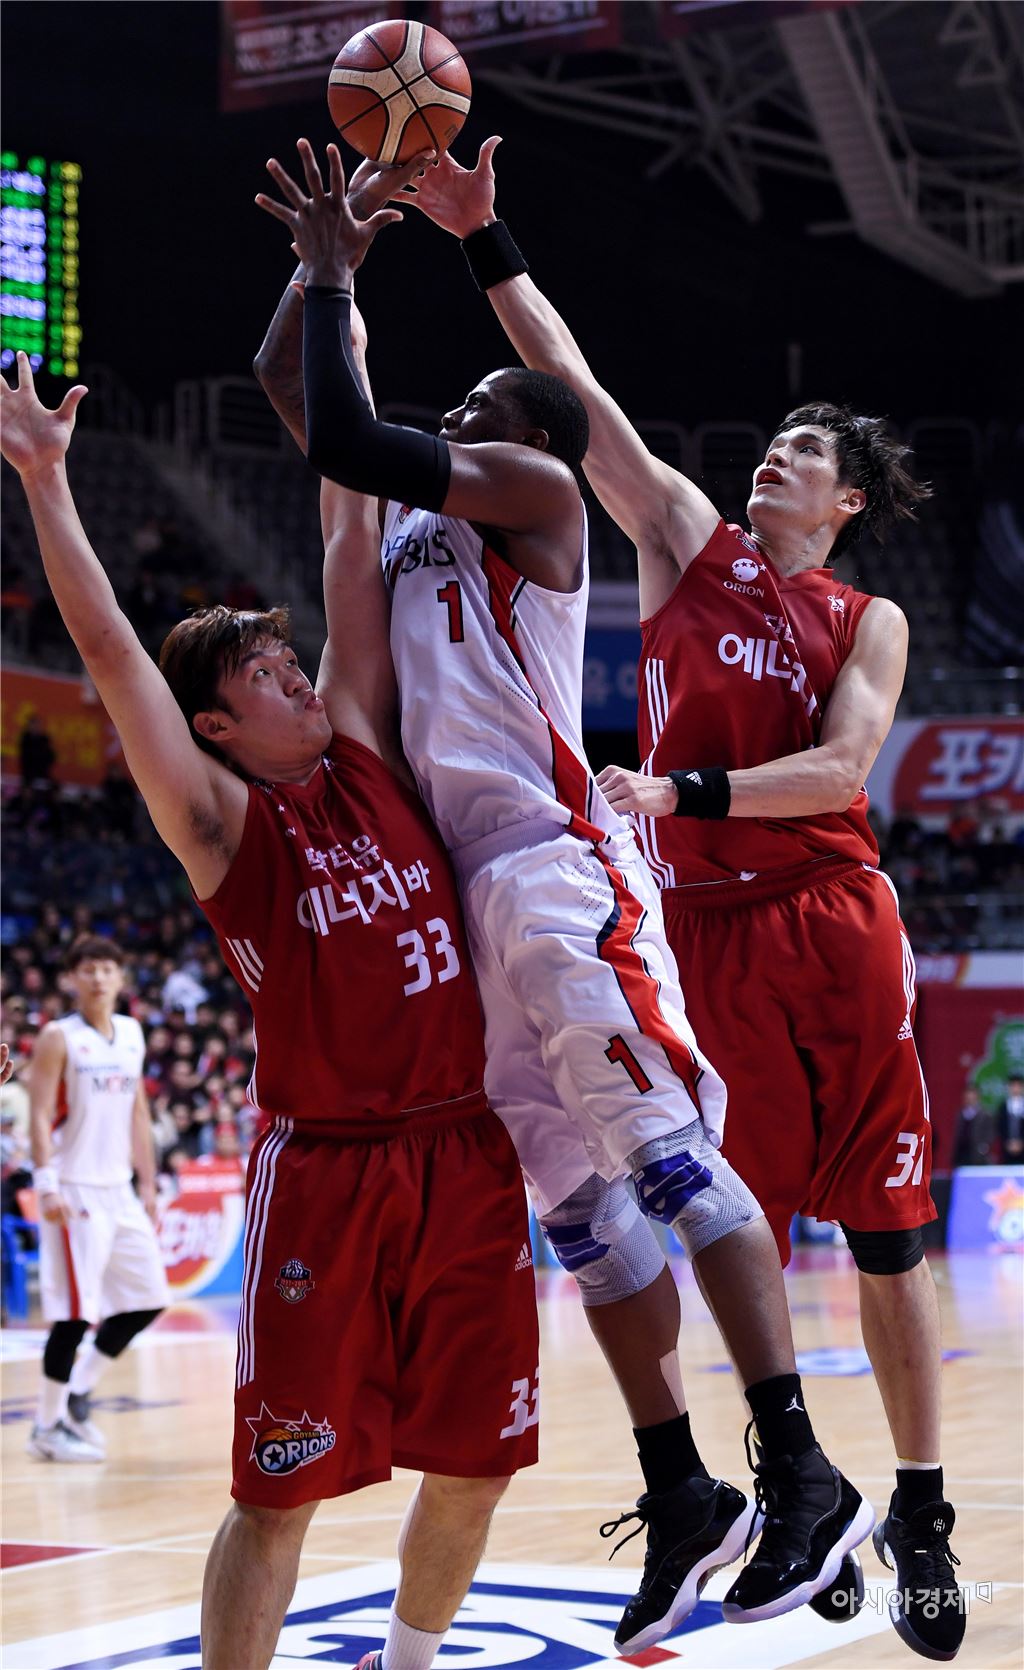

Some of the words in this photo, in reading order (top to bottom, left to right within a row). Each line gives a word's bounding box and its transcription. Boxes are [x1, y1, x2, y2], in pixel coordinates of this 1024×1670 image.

[437, 580, 465, 643] 1
[723, 580, 765, 598] ORION
[396, 917, 461, 997] 33
[604, 1033, 654, 1095] 1
[262, 1433, 335, 1471] ORIONS
